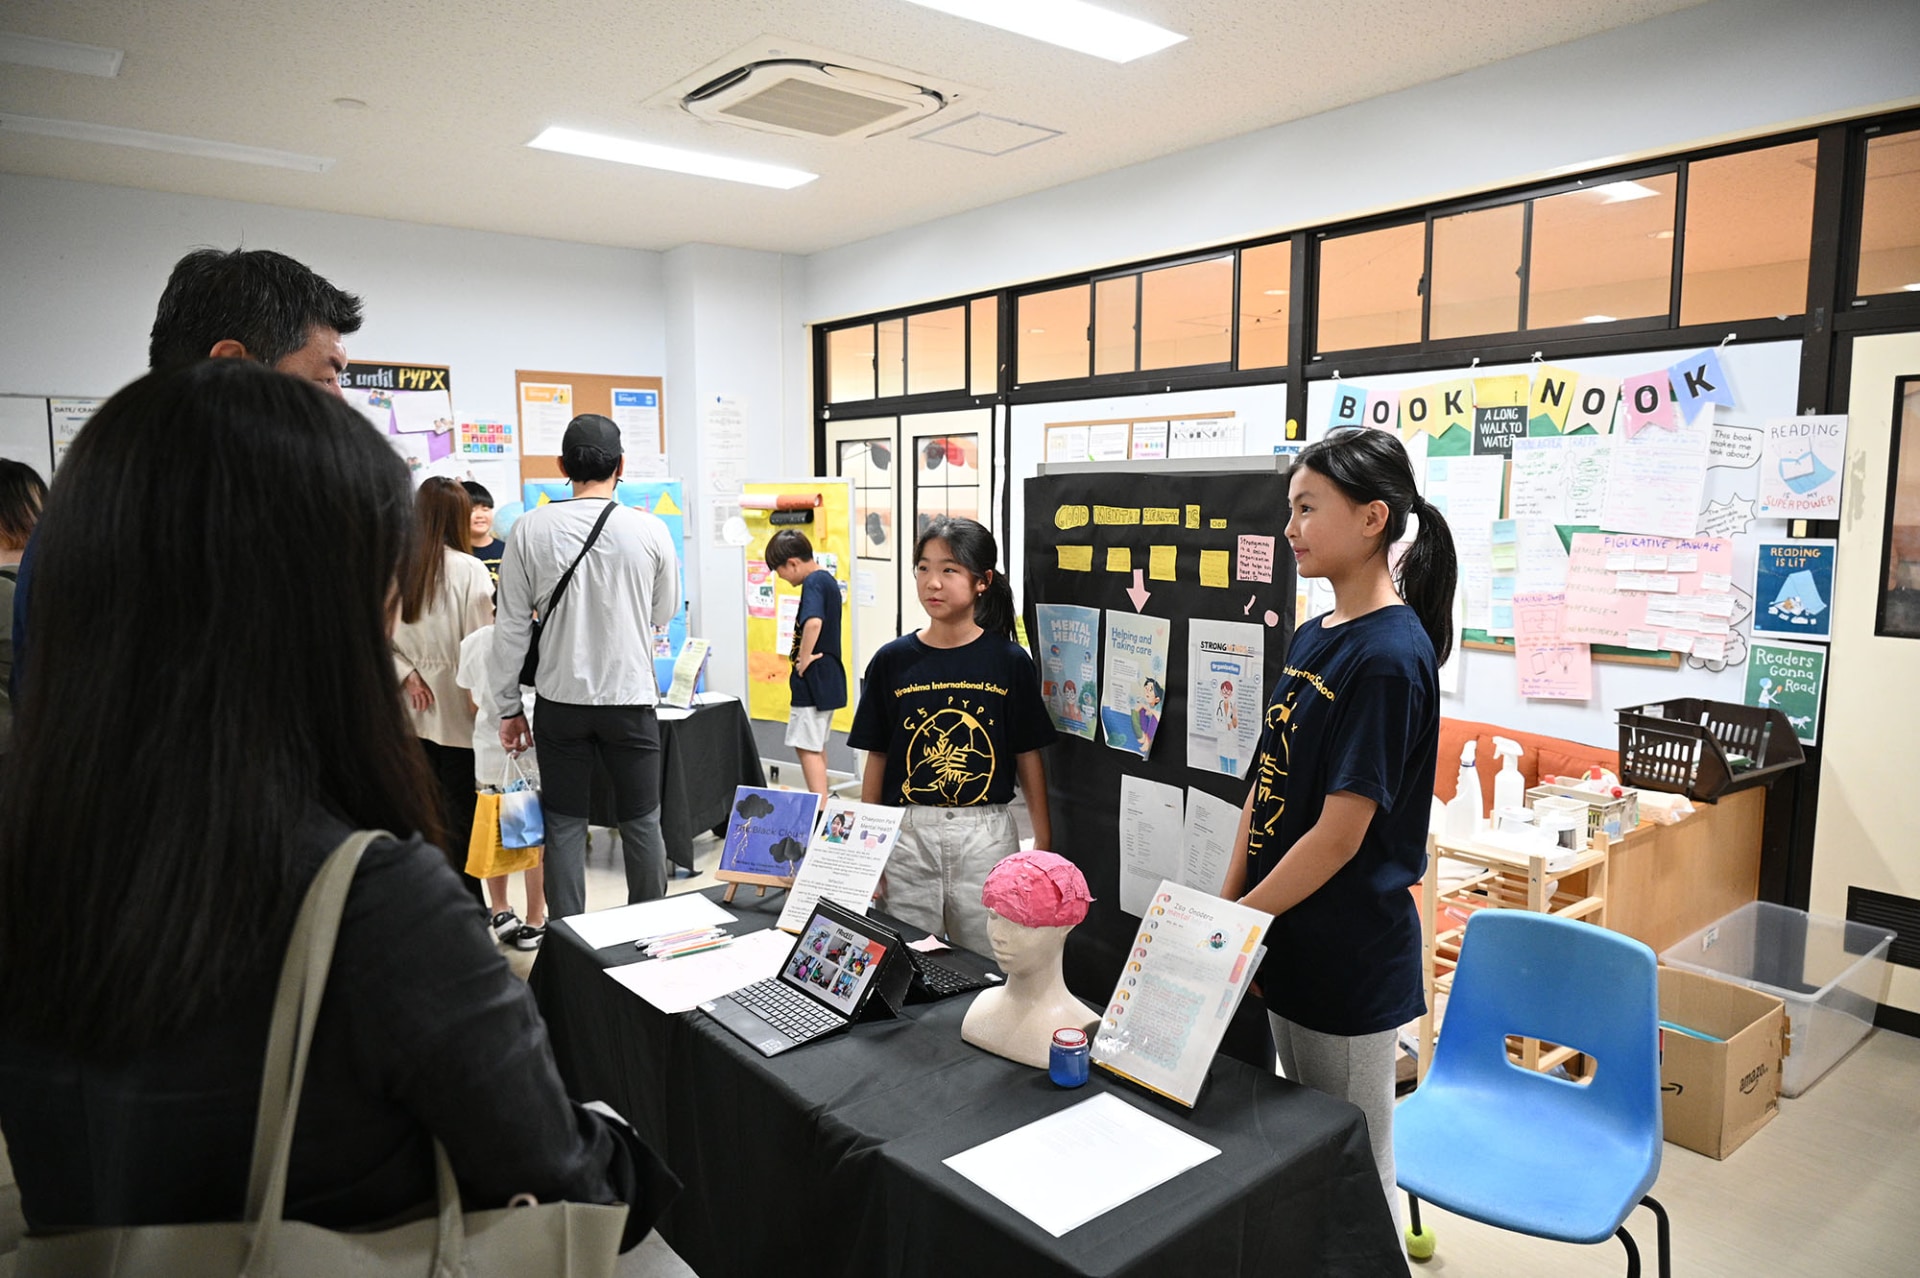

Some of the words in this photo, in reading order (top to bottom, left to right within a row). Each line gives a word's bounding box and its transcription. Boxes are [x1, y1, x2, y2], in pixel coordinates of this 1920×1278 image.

[356, 368, 394, 388] until
[398, 368, 446, 390] PYPX
[1338, 389, 1464, 424] BOOK
[1540, 363, 1716, 416] NOOK
[1484, 409, 1492, 421] A
[1493, 408, 1519, 421] LONG
[1480, 423, 1509, 434] WALK
[1509, 422, 1523, 434] TO
[1771, 424, 1839, 438] READING
[1714, 430, 1731, 440] This
[1733, 431, 1753, 442] book
[1711, 440, 1736, 449] makes
[1763, 494, 1836, 510] SUPERPOWER
[1604, 536, 1671, 549] FIGURATIVE
[1050, 619, 1091, 637] MENTAL
[1053, 630, 1091, 648] HEALTH
[1111, 628, 1138, 645] Helping
[1138, 632, 1153, 645] and
[1111, 638, 1136, 655] Taking
[1136, 647, 1153, 657] care
[1755, 648, 1815, 668] Readers
[1769, 665, 1815, 680] Gonna
[931, 681, 984, 691] International
[752, 825, 776, 836] Black
